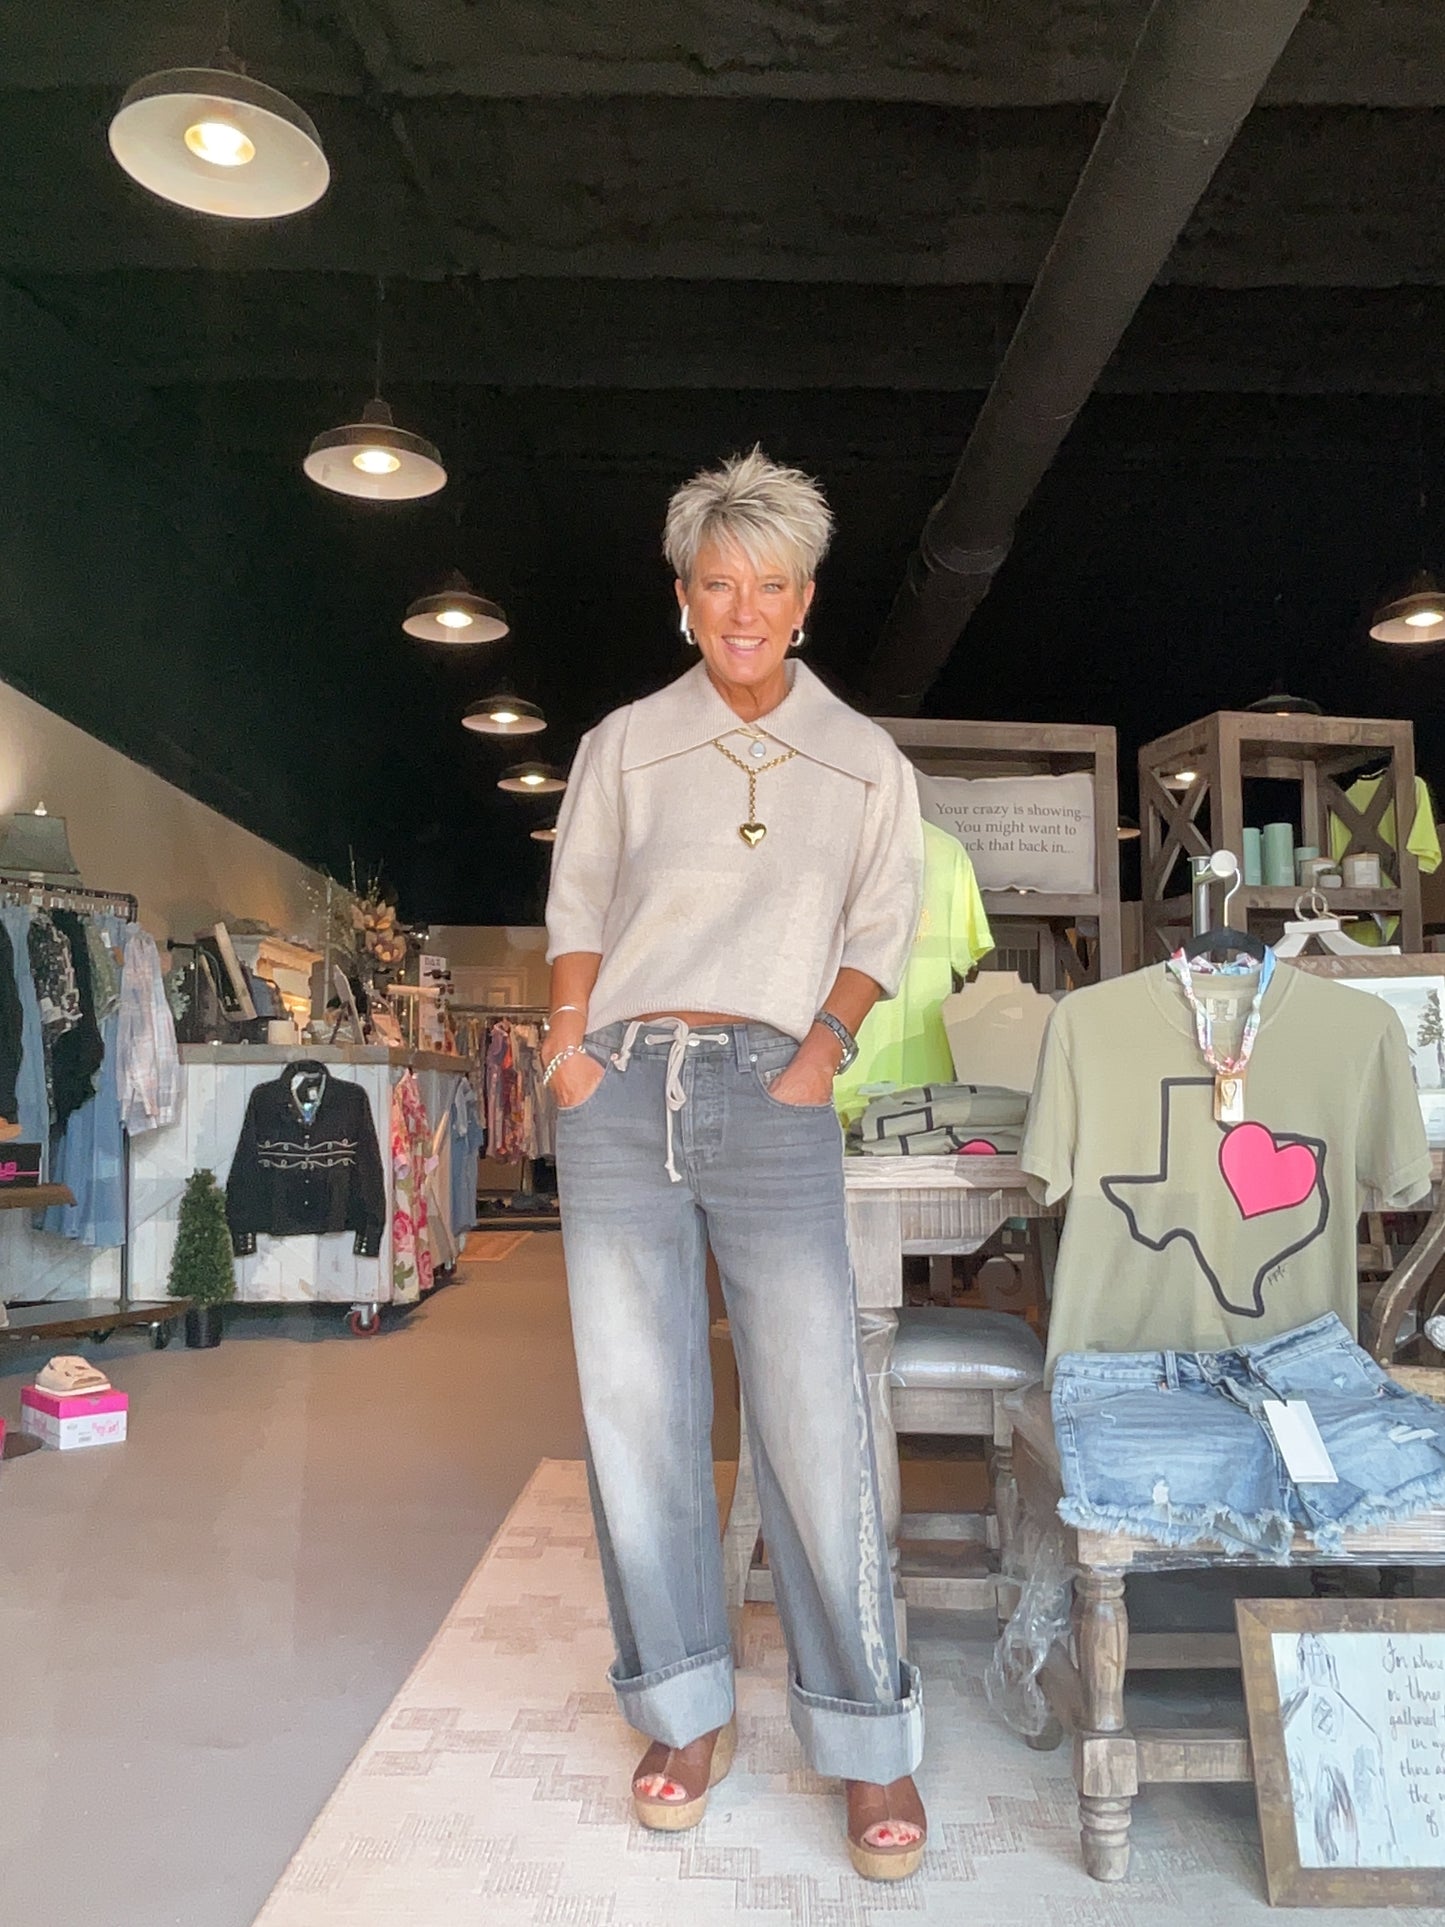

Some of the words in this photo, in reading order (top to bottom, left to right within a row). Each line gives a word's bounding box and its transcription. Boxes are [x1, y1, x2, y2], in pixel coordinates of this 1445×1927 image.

[936, 802, 969, 815] Your
[972, 805, 1009, 818] crazy
[1013, 802, 1024, 815] is
[955, 820, 981, 833] You
[985, 820, 1025, 837] might
[1029, 823, 1061, 836] want
[1064, 824, 1077, 836] to
[964, 838, 985, 851] uck
[988, 838, 1014, 851] that
[1019, 838, 1049, 853] back
[1052, 840, 1074, 854] in...
[1408, 1783, 1431, 1804] the
